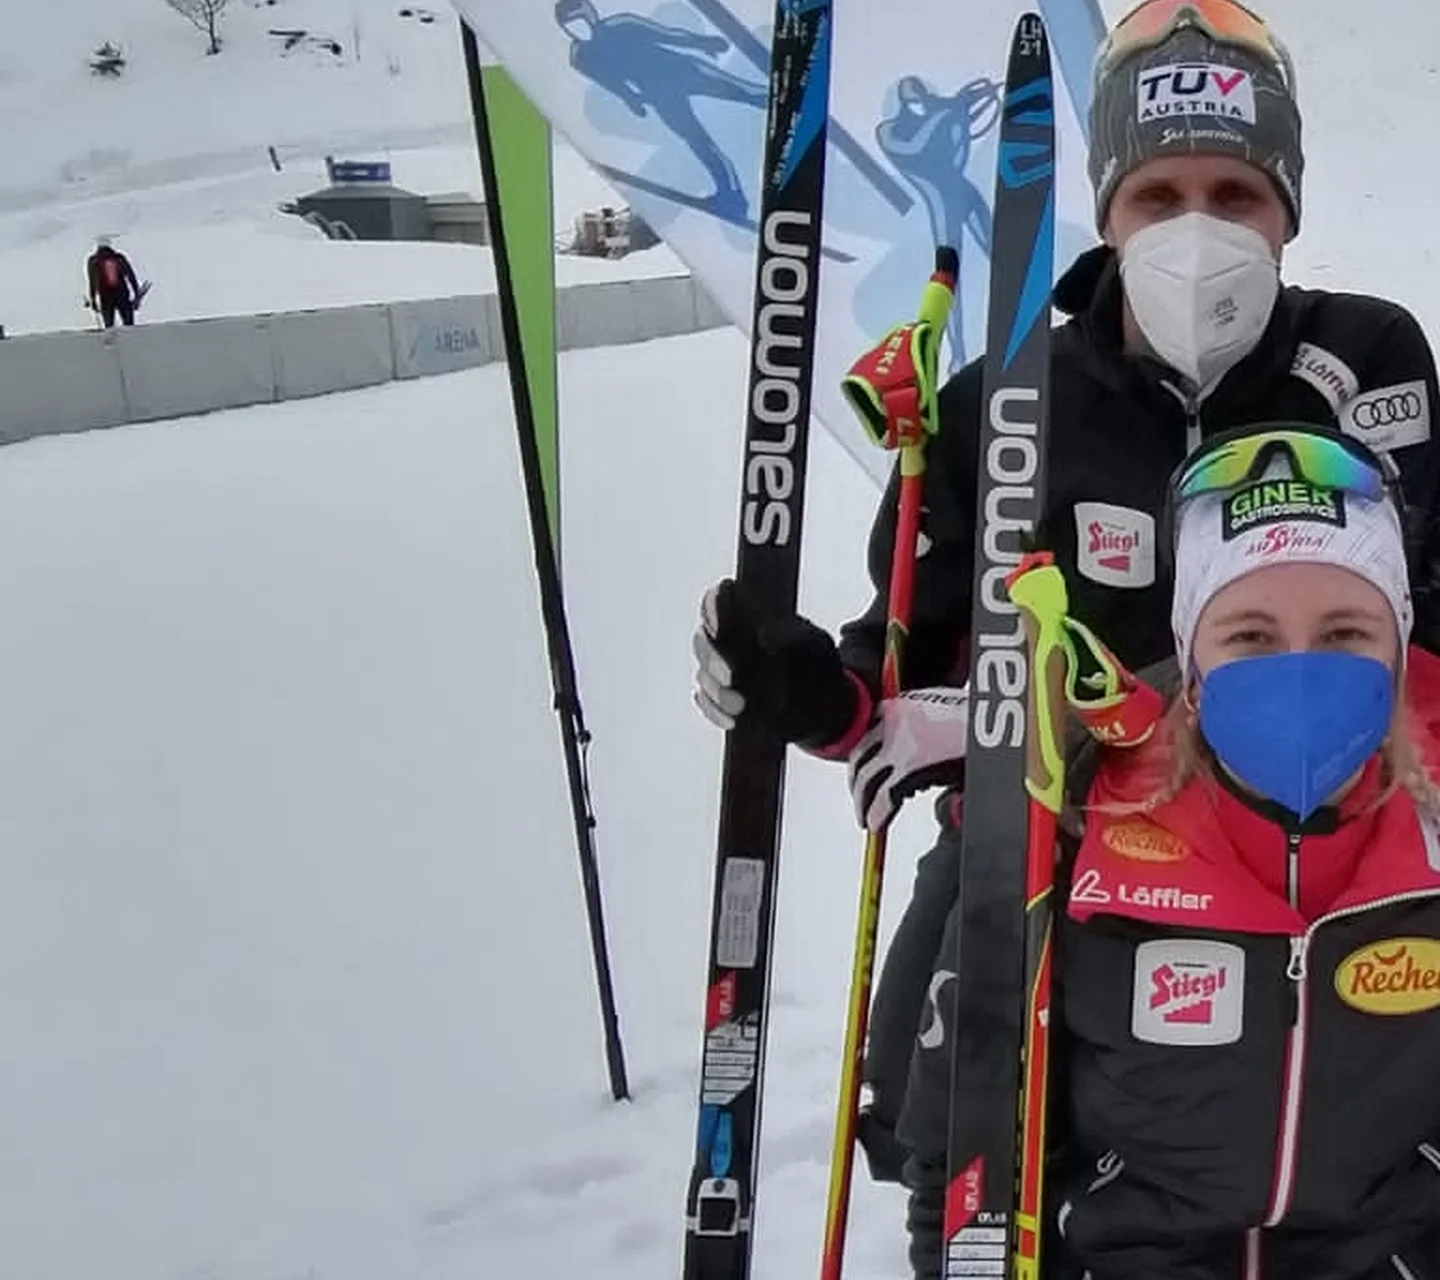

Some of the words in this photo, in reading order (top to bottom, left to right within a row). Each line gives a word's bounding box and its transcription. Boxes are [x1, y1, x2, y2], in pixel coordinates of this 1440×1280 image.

[1021, 19, 1043, 39] LH
[1019, 40, 1042, 56] 21
[1141, 101, 1242, 119] AUSTRIA
[745, 210, 811, 548] salomon
[974, 387, 1039, 750] salomon
[1117, 884, 1214, 911] Löffler
[1149, 963, 1228, 1010] Stiegl
